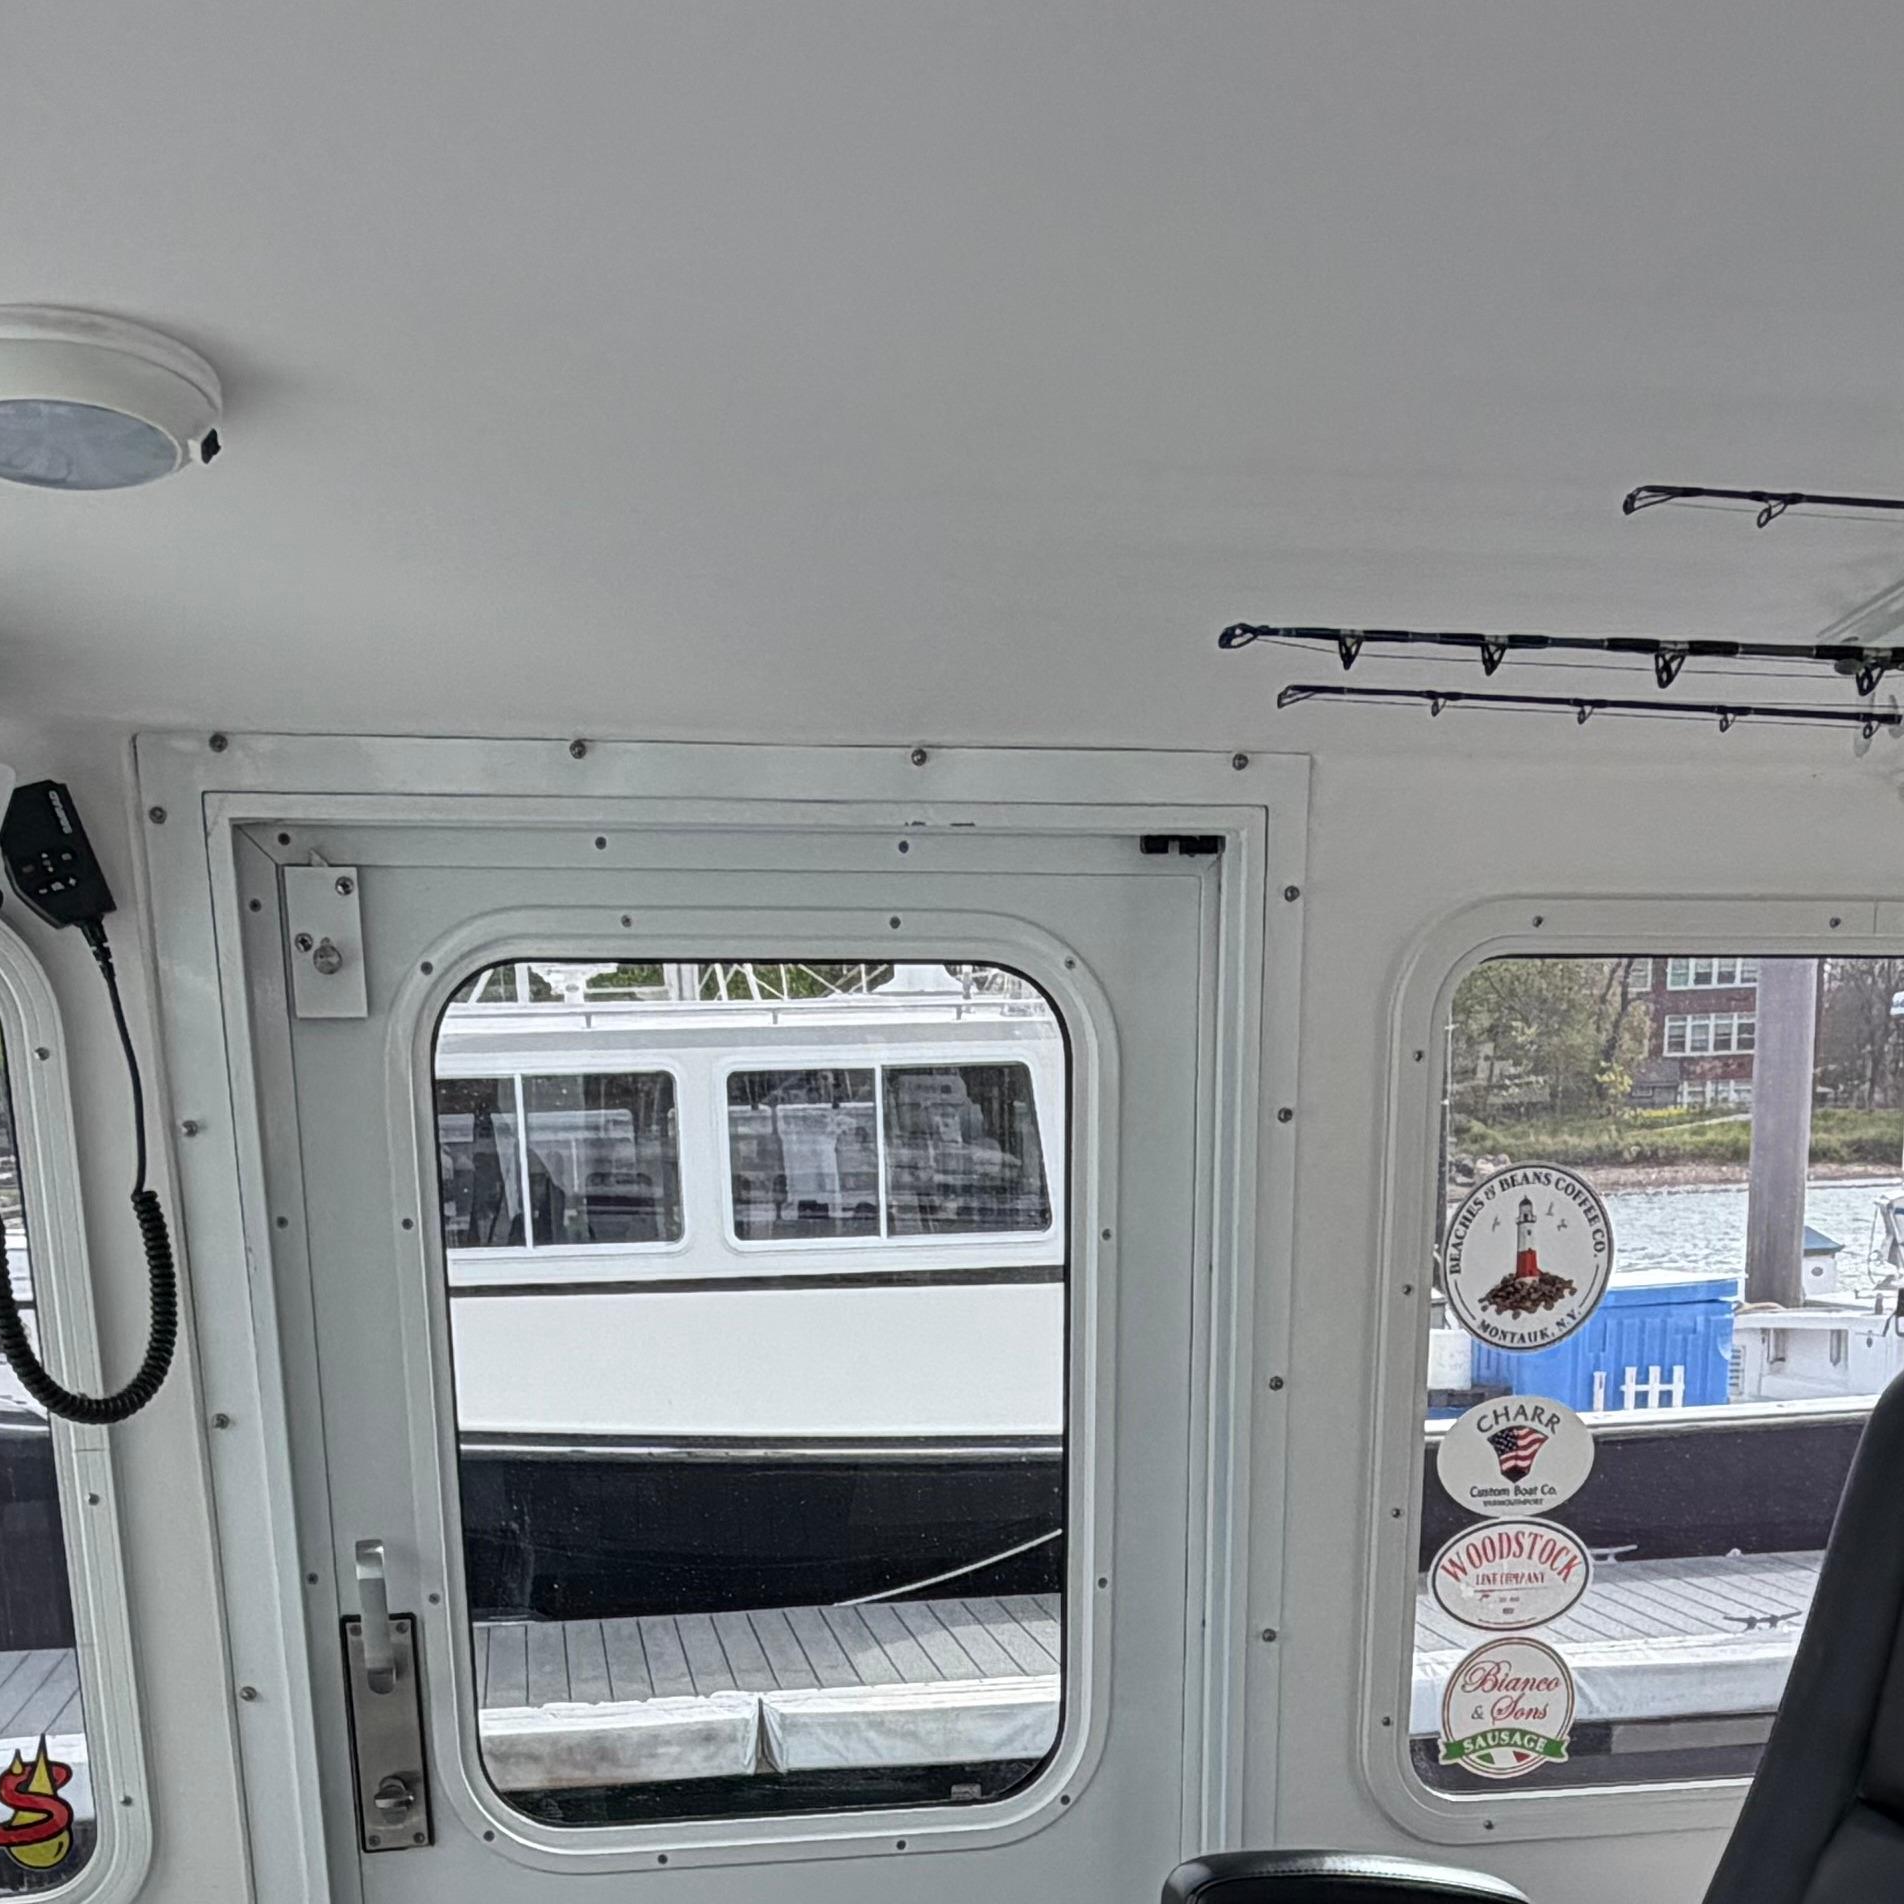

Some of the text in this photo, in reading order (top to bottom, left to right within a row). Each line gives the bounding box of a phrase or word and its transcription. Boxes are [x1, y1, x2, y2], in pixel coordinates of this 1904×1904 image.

[1449, 1171, 1606, 1275] BEACHES & BEANS COFFEE CO.
[1478, 1310, 1582, 1344] MONTAUK, N.Y.
[1476, 1404, 1561, 1434] CHARR
[1469, 1486, 1510, 1498] Custom
[1514, 1485, 1538, 1497] Boat
[1440, 1531, 1582, 1583] WOODSTOCK
[1461, 1660, 1560, 1693] Bianco
[1471, 1693, 1549, 1726] & Sons
[1463, 1731, 1548, 1753] SAUSAGE
